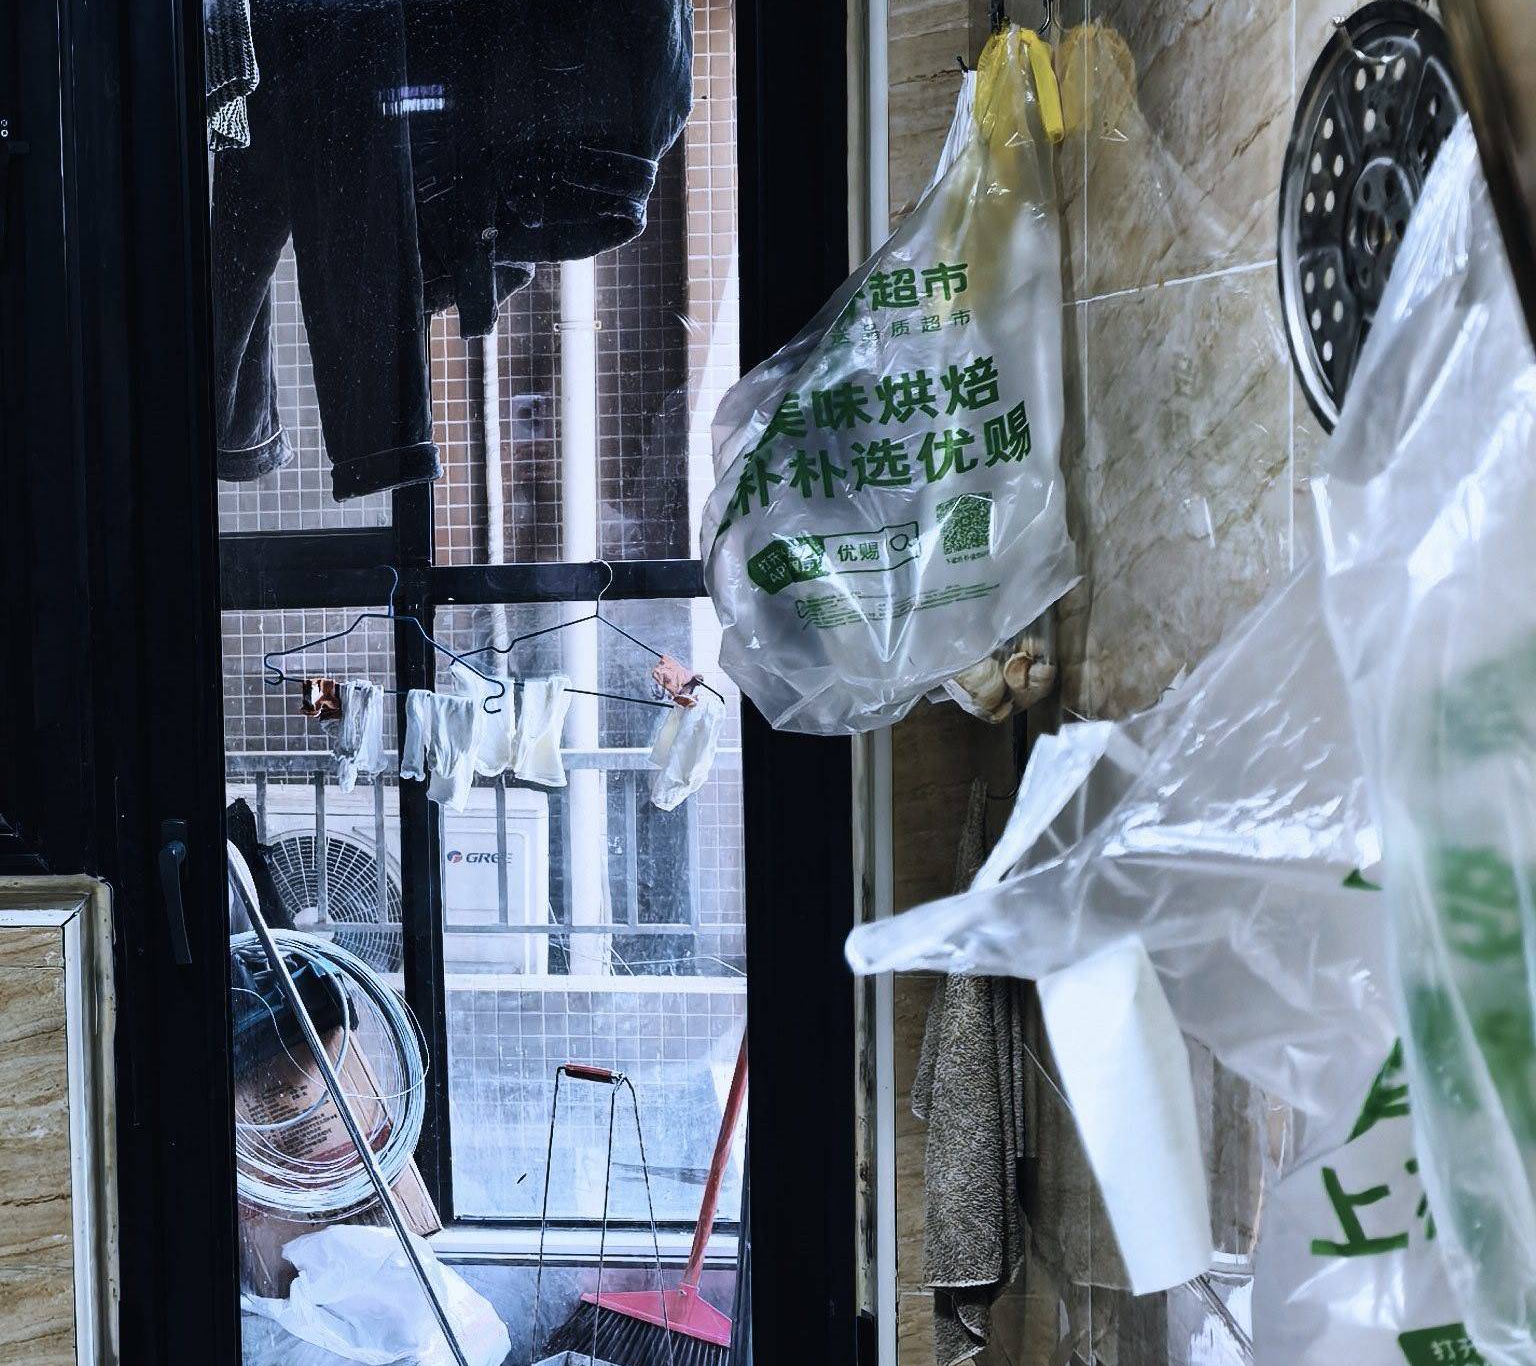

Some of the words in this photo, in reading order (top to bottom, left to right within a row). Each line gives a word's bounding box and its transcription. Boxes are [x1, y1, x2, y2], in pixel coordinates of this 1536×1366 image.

[849, 262, 968, 315] 超市
[758, 356, 1000, 444] 美味烘焙
[837, 541, 880, 562] 优赐
